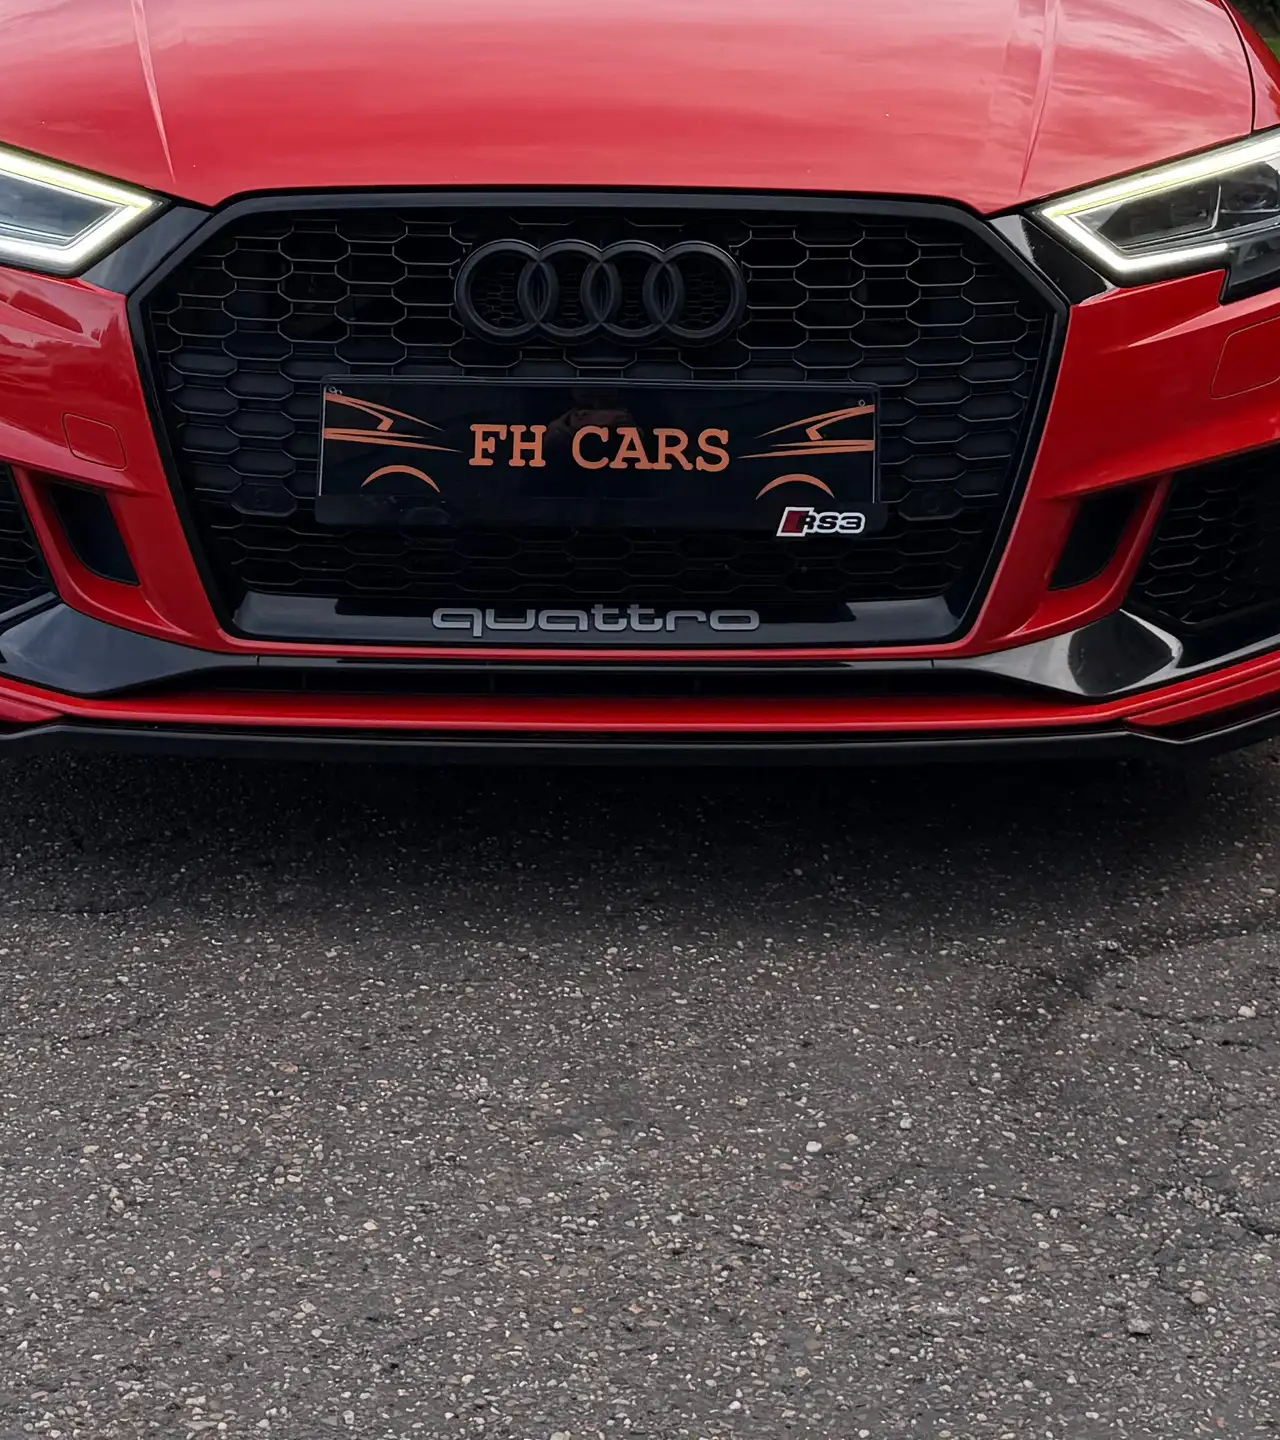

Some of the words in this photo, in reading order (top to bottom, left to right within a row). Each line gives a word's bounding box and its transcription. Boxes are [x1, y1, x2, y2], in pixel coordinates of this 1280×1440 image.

[468, 423, 546, 467] FH
[571, 427, 730, 473] CARS
[784, 507, 866, 536] RS3
[432, 603, 761, 638] quattro
